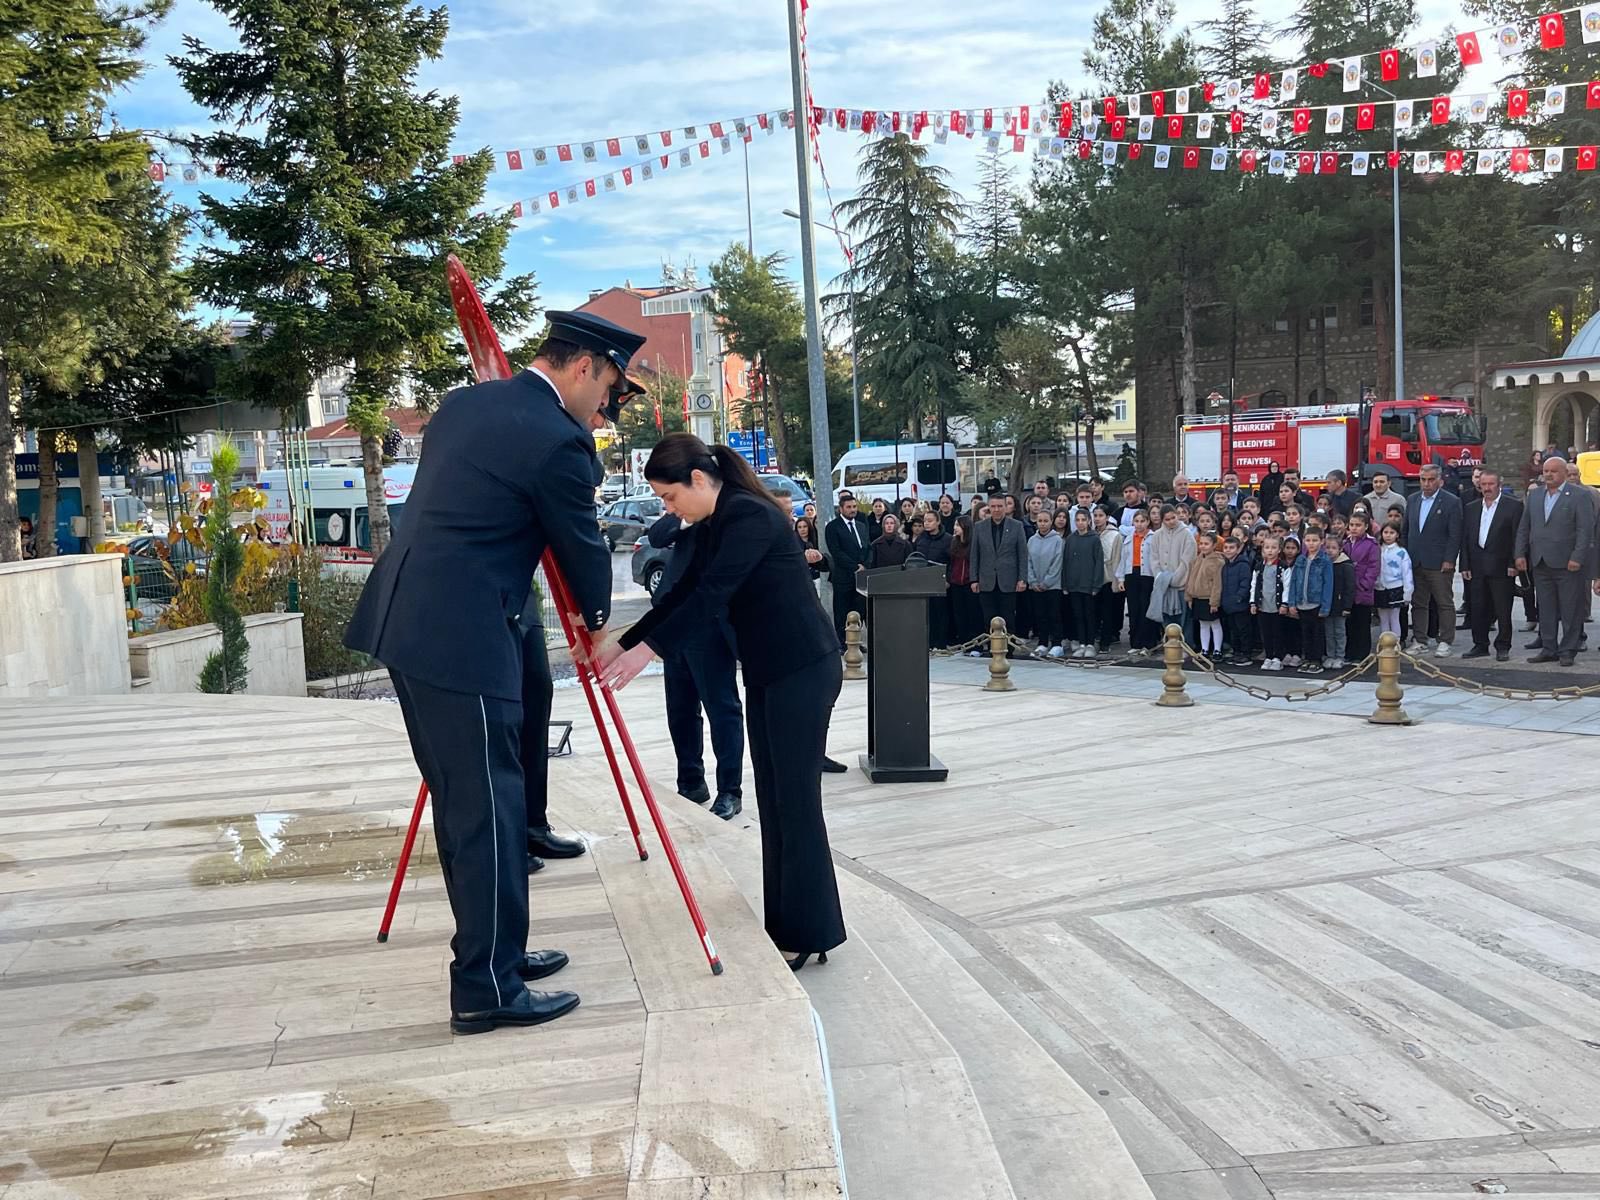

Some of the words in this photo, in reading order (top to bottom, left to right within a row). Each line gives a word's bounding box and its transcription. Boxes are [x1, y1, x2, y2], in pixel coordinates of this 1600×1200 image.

[1233, 423, 1275, 432] SENİRKENT
[1233, 439, 1276, 448] BELEDİYESİ
[1236, 457, 1271, 465] İTFAİYESİ
